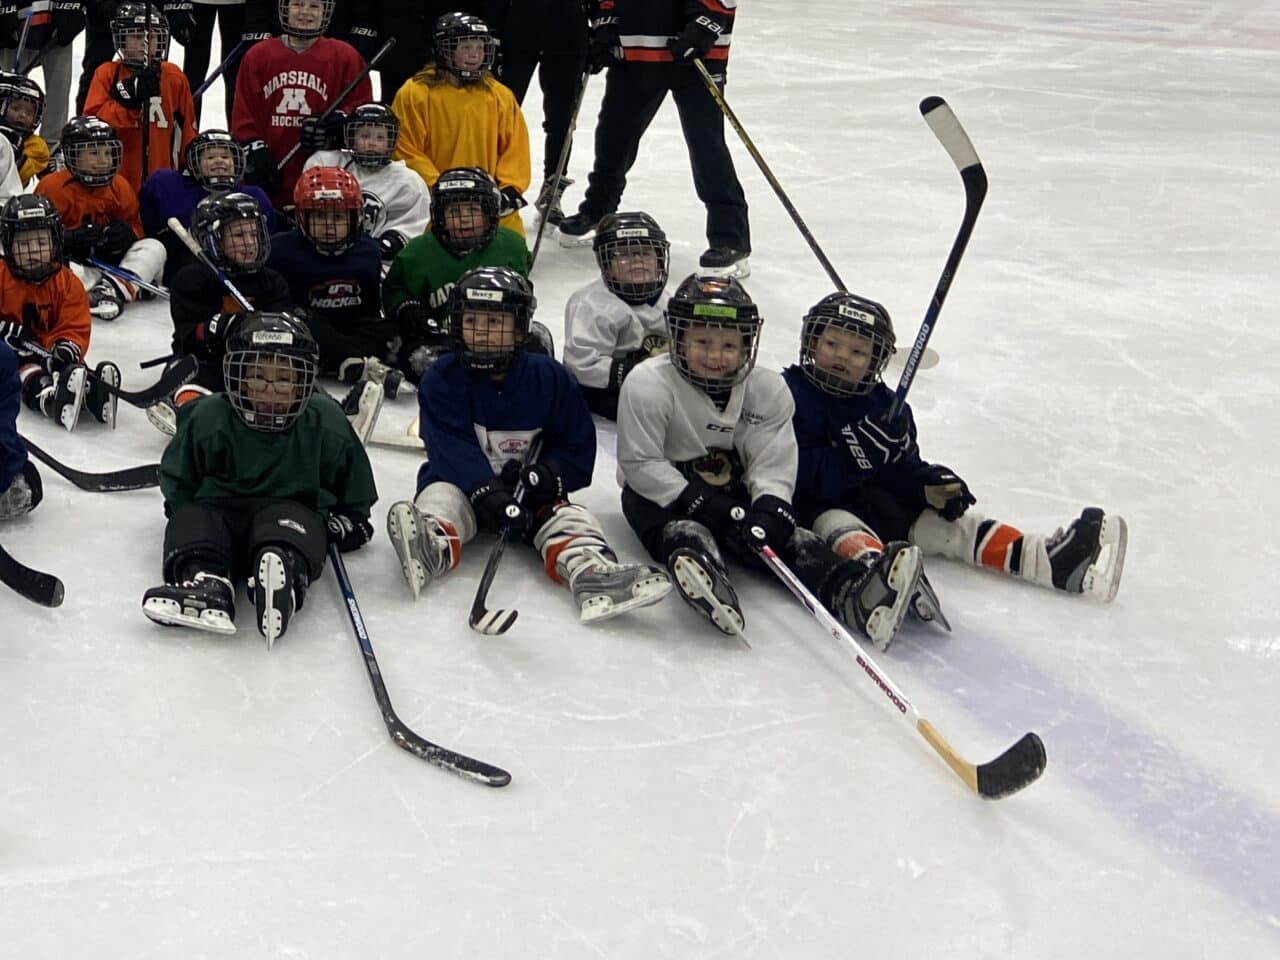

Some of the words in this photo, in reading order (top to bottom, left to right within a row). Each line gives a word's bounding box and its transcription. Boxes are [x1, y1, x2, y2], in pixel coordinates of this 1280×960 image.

[263, 70, 329, 102] MARSHALL
[271, 115, 303, 127] HOCK
[900, 322, 931, 390] SHERWOOD
[706, 422, 734, 433] CC
[855, 654, 907, 715] SHERWOOD
